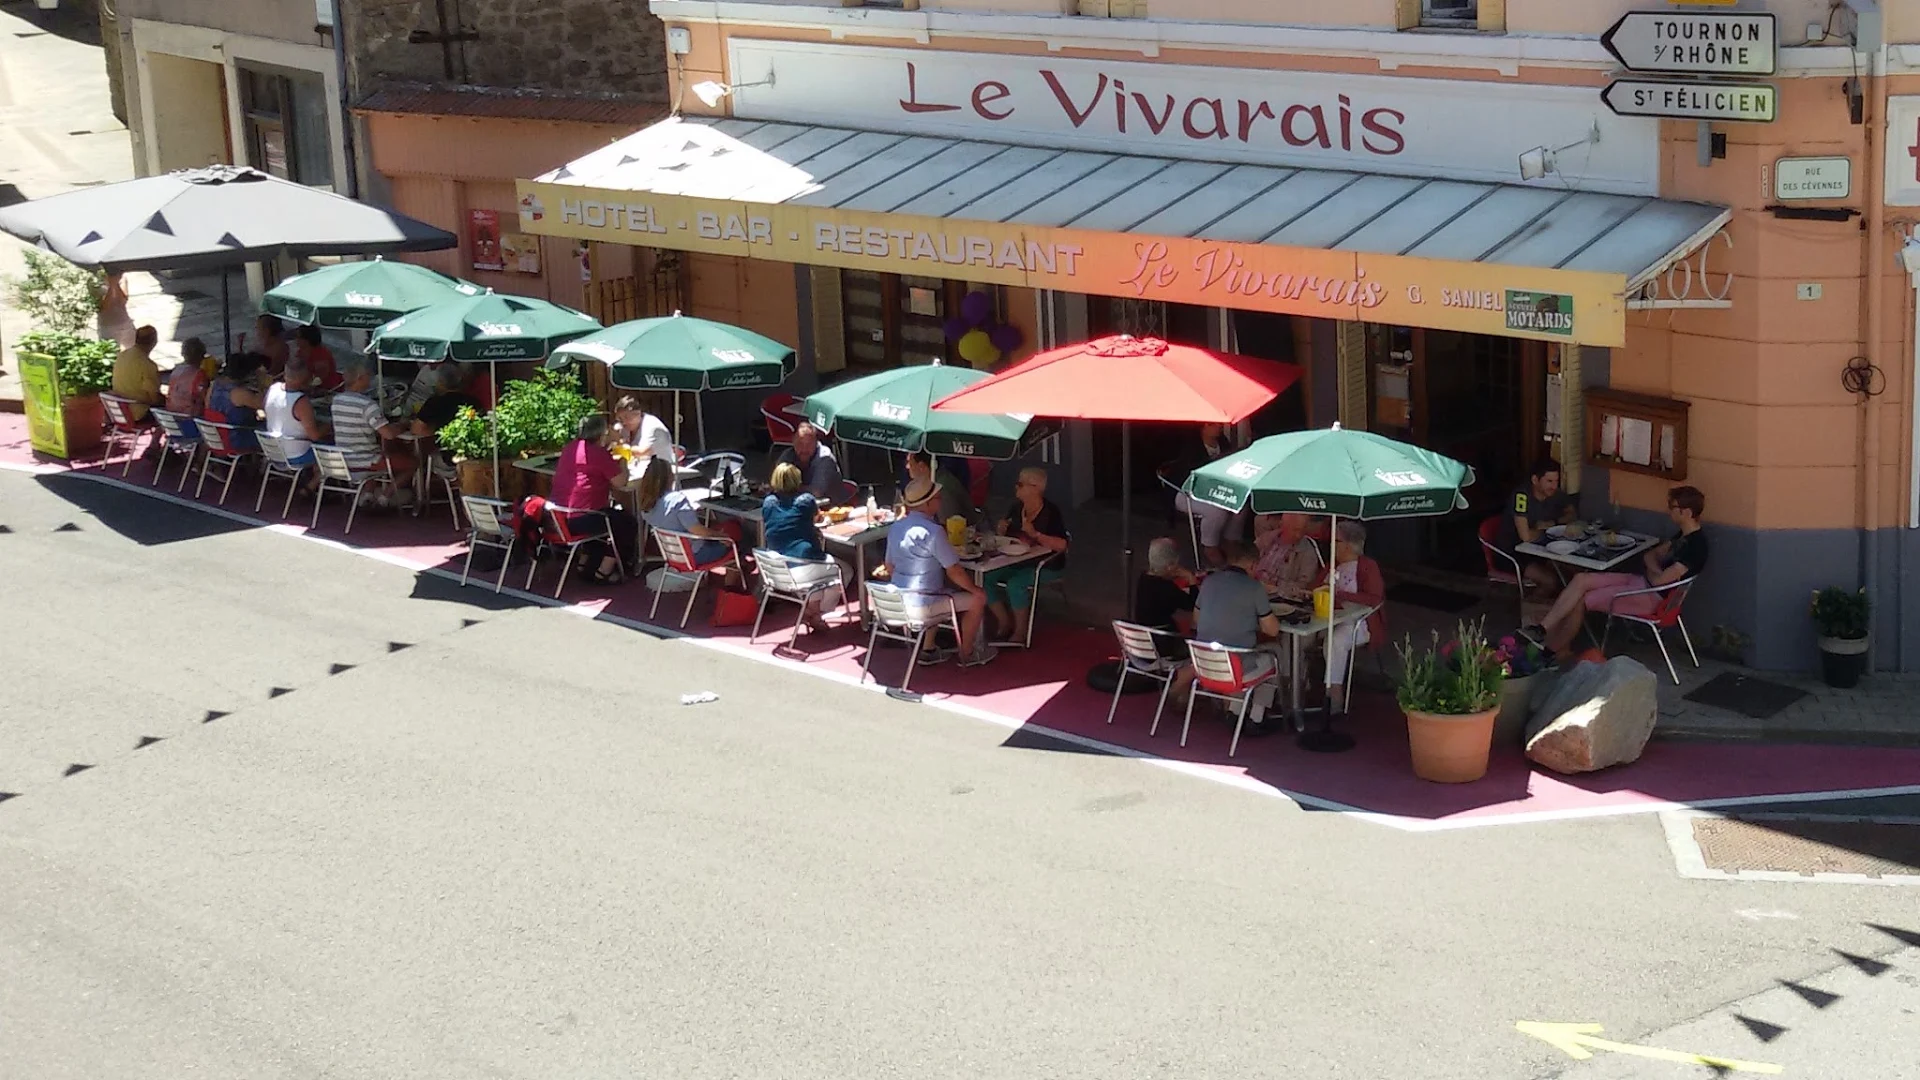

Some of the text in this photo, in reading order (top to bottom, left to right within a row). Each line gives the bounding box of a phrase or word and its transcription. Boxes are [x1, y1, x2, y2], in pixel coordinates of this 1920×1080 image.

[1654, 22, 1760, 41] TOURNON
[1673, 43, 1749, 65] RHÔNE
[900, 61, 1406, 156] Le Vivarais
[1664, 88, 1766, 113] FÉLICIEN
[1805, 168, 1822, 176] RUE
[1782, 181, 1843, 191] DES CÉVENNES
[560, 199, 1084, 276] HOTEL BAR RESTAURANT
[1119, 242, 1179, 296] Le
[1194, 248, 1389, 309] Vivarais
[1442, 288, 1503, 312] SANIEL
[1806, 286, 1812, 297] 1
[1507, 311, 1572, 329] MOTARDS
[645, 373, 669, 387] VALS
[952, 440, 974, 455] VALS
[1298, 495, 1327, 509] VALS
[1515, 493, 1527, 513] 6
